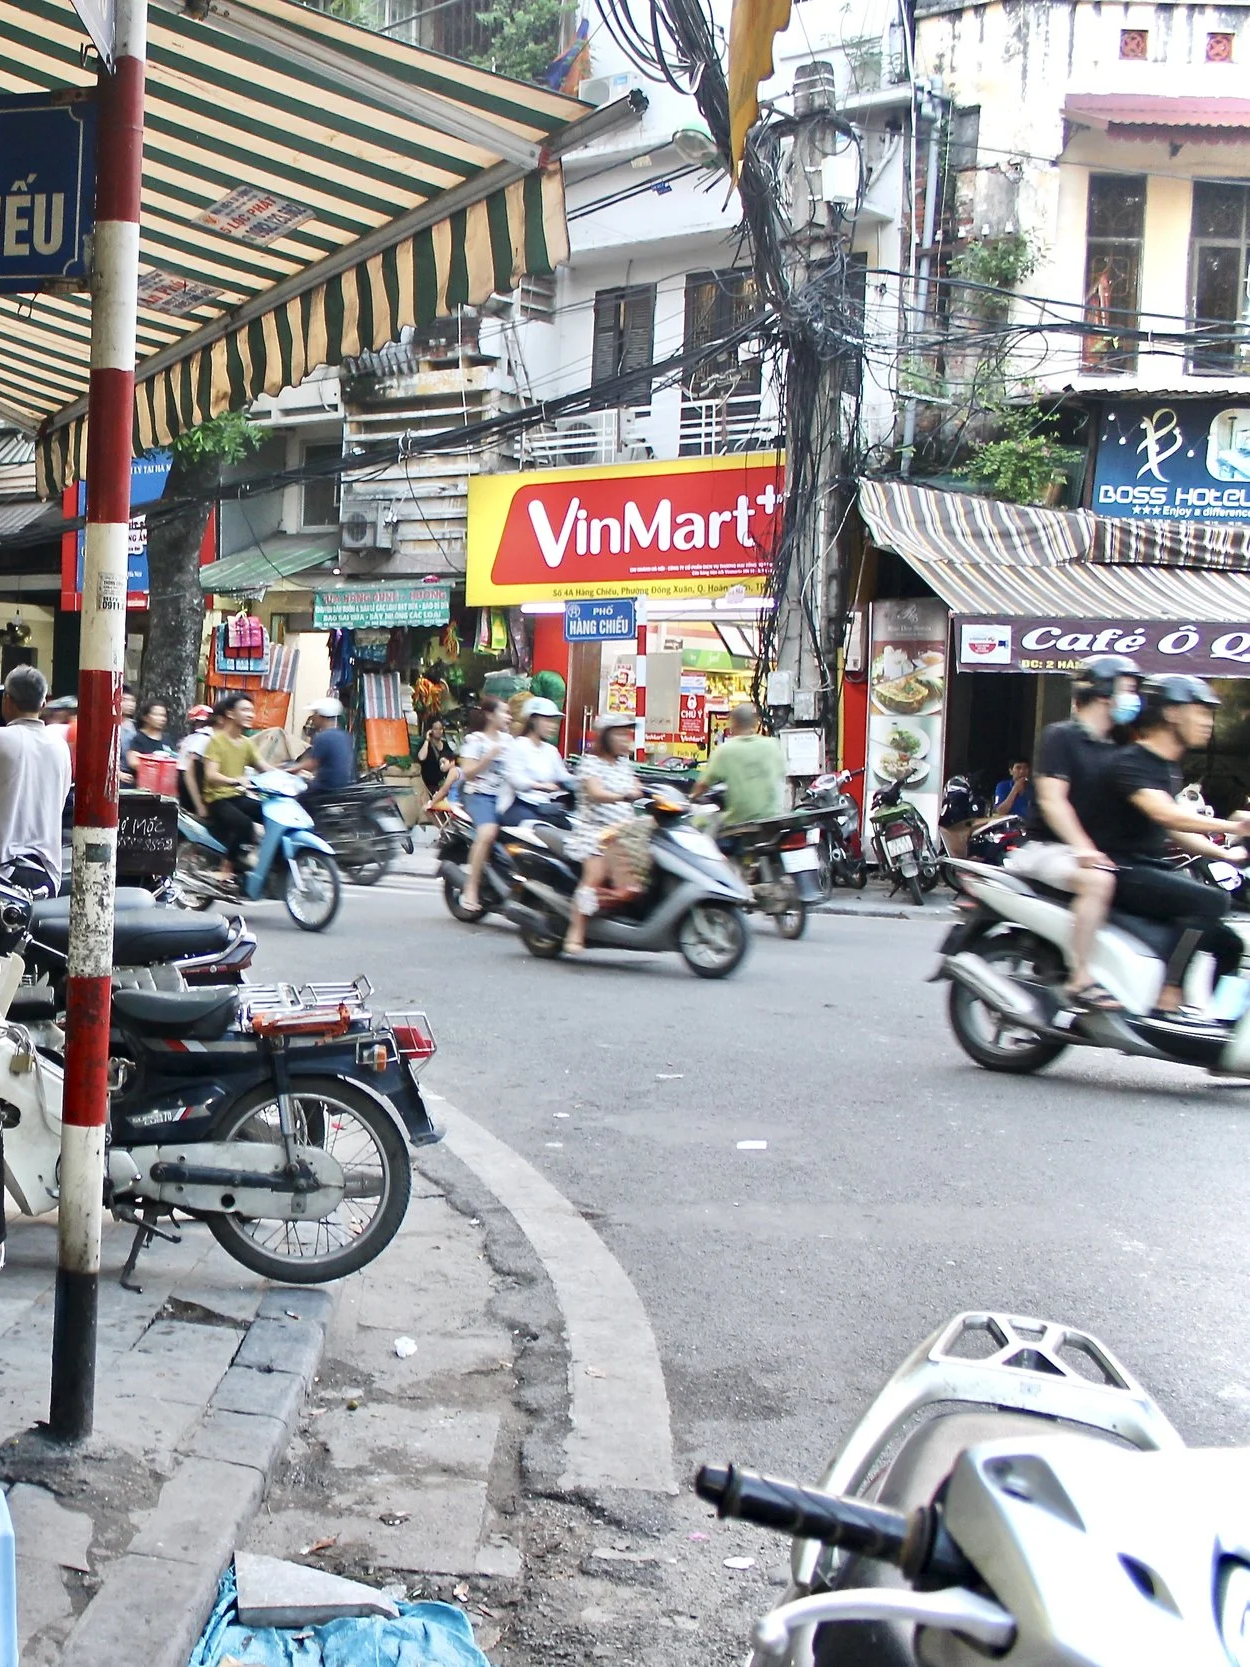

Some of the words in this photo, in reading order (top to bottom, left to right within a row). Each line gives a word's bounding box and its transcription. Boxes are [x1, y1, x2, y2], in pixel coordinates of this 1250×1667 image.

[1099, 485, 1168, 505] BOSS
[1163, 505, 1192, 518] Enjoy
[1194, 508, 1200, 517] a
[576, 588, 594, 598] Hàng
[593, 605, 614, 616] PHỐ
[570, 617, 597, 635] HÀNG
[599, 615, 629, 635] CHIẾU
[1021, 626, 1146, 653] Café
[1158, 624, 1200, 655] Ô
[1209, 632, 1250, 663] Q
[1046, 660, 1055, 669] 2
